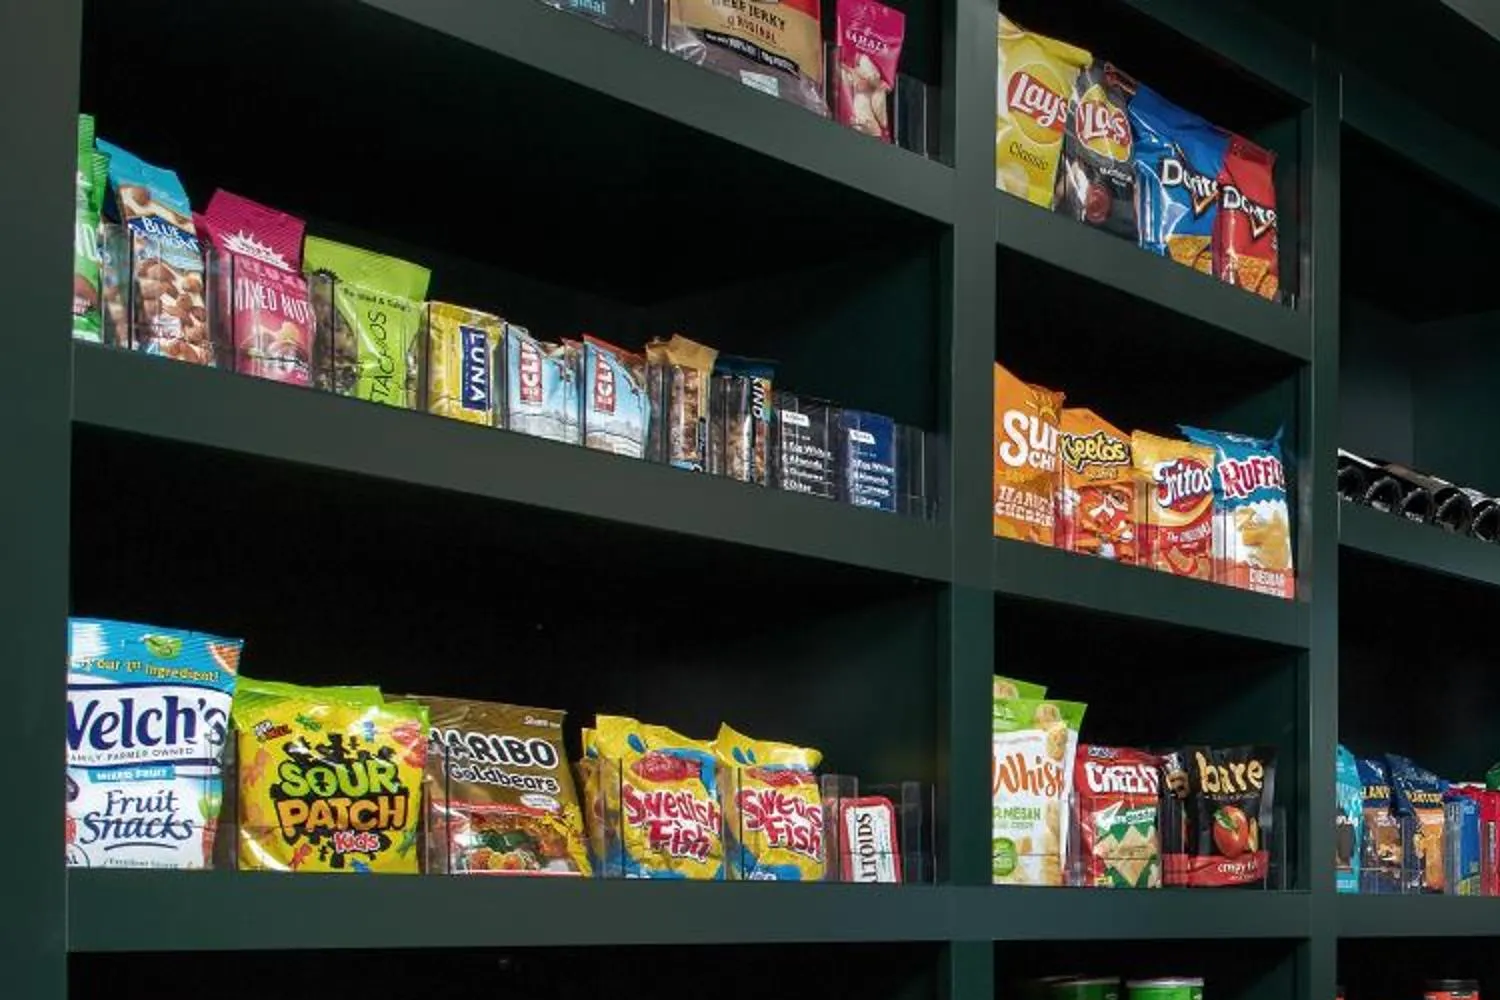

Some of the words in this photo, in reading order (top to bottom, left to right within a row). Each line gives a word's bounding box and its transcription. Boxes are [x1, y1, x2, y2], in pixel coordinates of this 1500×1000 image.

[1010, 72, 1067, 126] Lay's
[469, 331, 487, 402] LUNA
[1154, 461, 1214, 507] Fritos
[70, 752, 103, 763] AMILY
[448, 761, 560, 793] Goldbears
[1195, 751, 1265, 794] bare
[282, 762, 399, 797] SOUR
[104, 790, 180, 817] Fruit
[276, 796, 409, 837] PATCH
[621, 784, 723, 836] Swedish
[80, 810, 194, 844] Snacks
[333, 829, 381, 851] Kids
[648, 818, 713, 863] Fish
[763, 817, 822, 862] Fish
